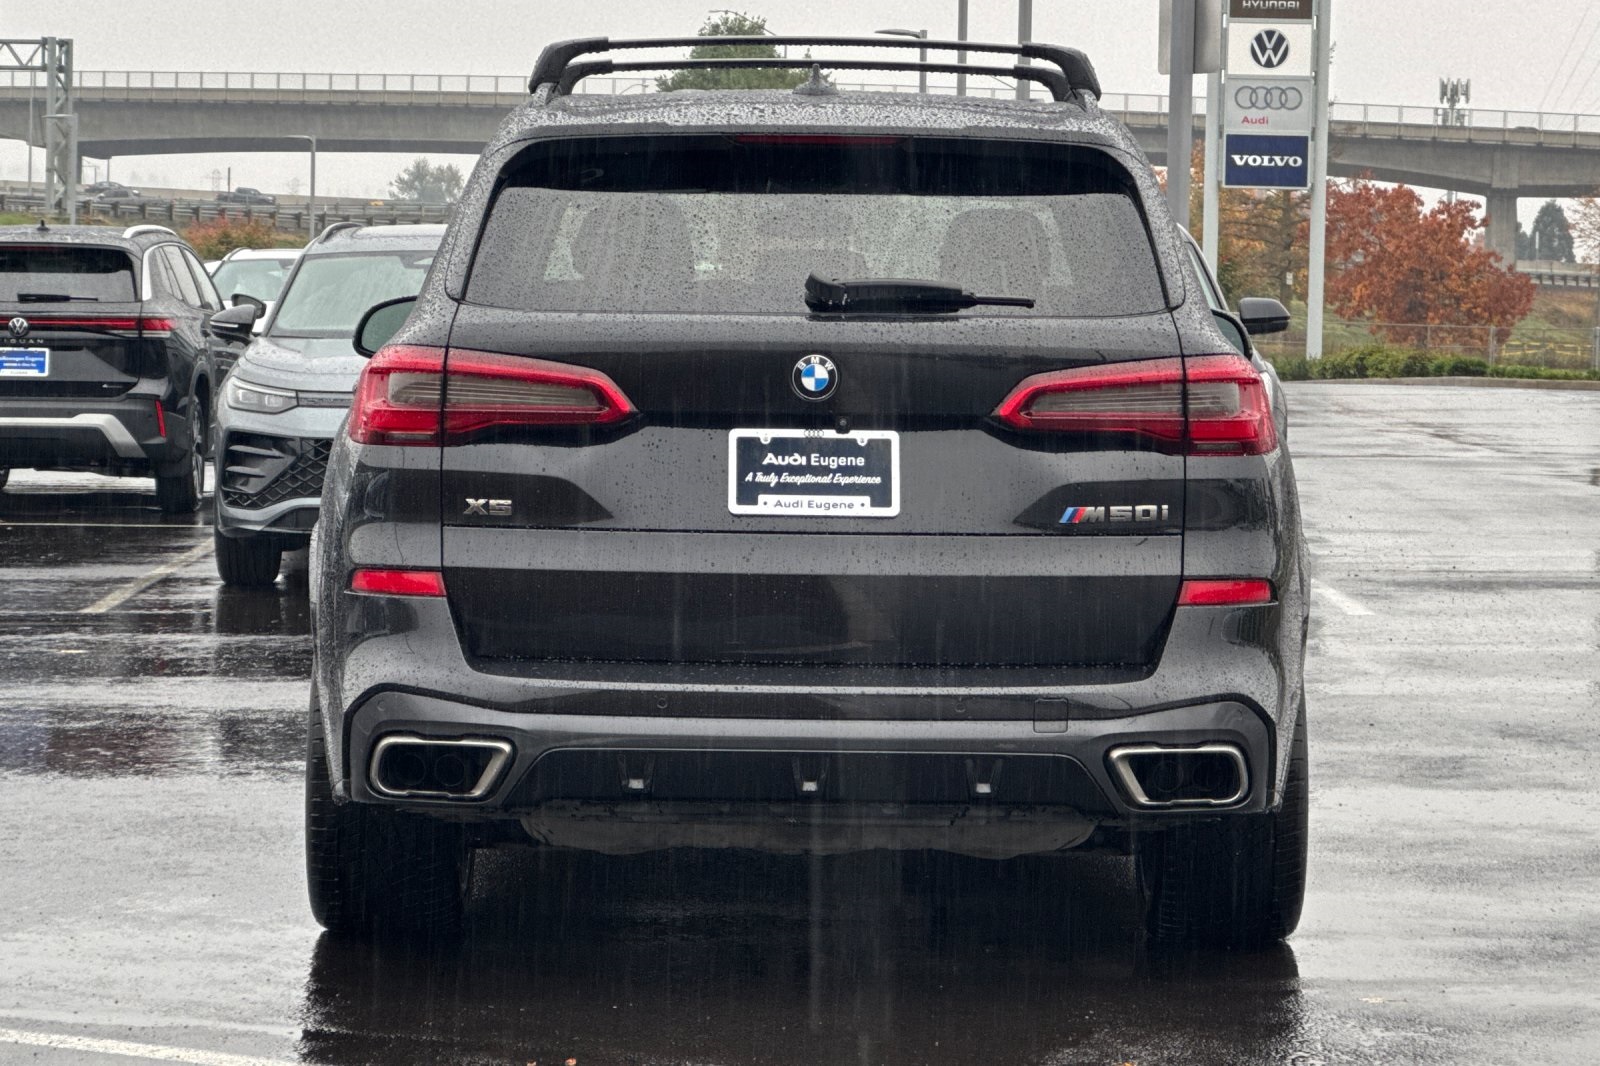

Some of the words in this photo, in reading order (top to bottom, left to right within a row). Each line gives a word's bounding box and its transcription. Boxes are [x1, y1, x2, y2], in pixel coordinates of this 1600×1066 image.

[1242, 0, 1300, 9] HYUNDAI
[1241, 116, 1269, 125] Audi
[1231, 155, 1303, 167] VOLVO
[797, 356, 834, 371] BMW
[762, 453, 807, 465] Audi
[810, 454, 865, 469] Eugene
[745, 472, 753, 482] A
[755, 472, 778, 487] Truly
[780, 472, 832, 485] Exceptional
[833, 473, 882, 486] Experience
[463, 498, 512, 515] X5
[774, 500, 803, 508] Audi
[807, 500, 855, 510] Eugene
[1080, 505, 1169, 522] M50i
